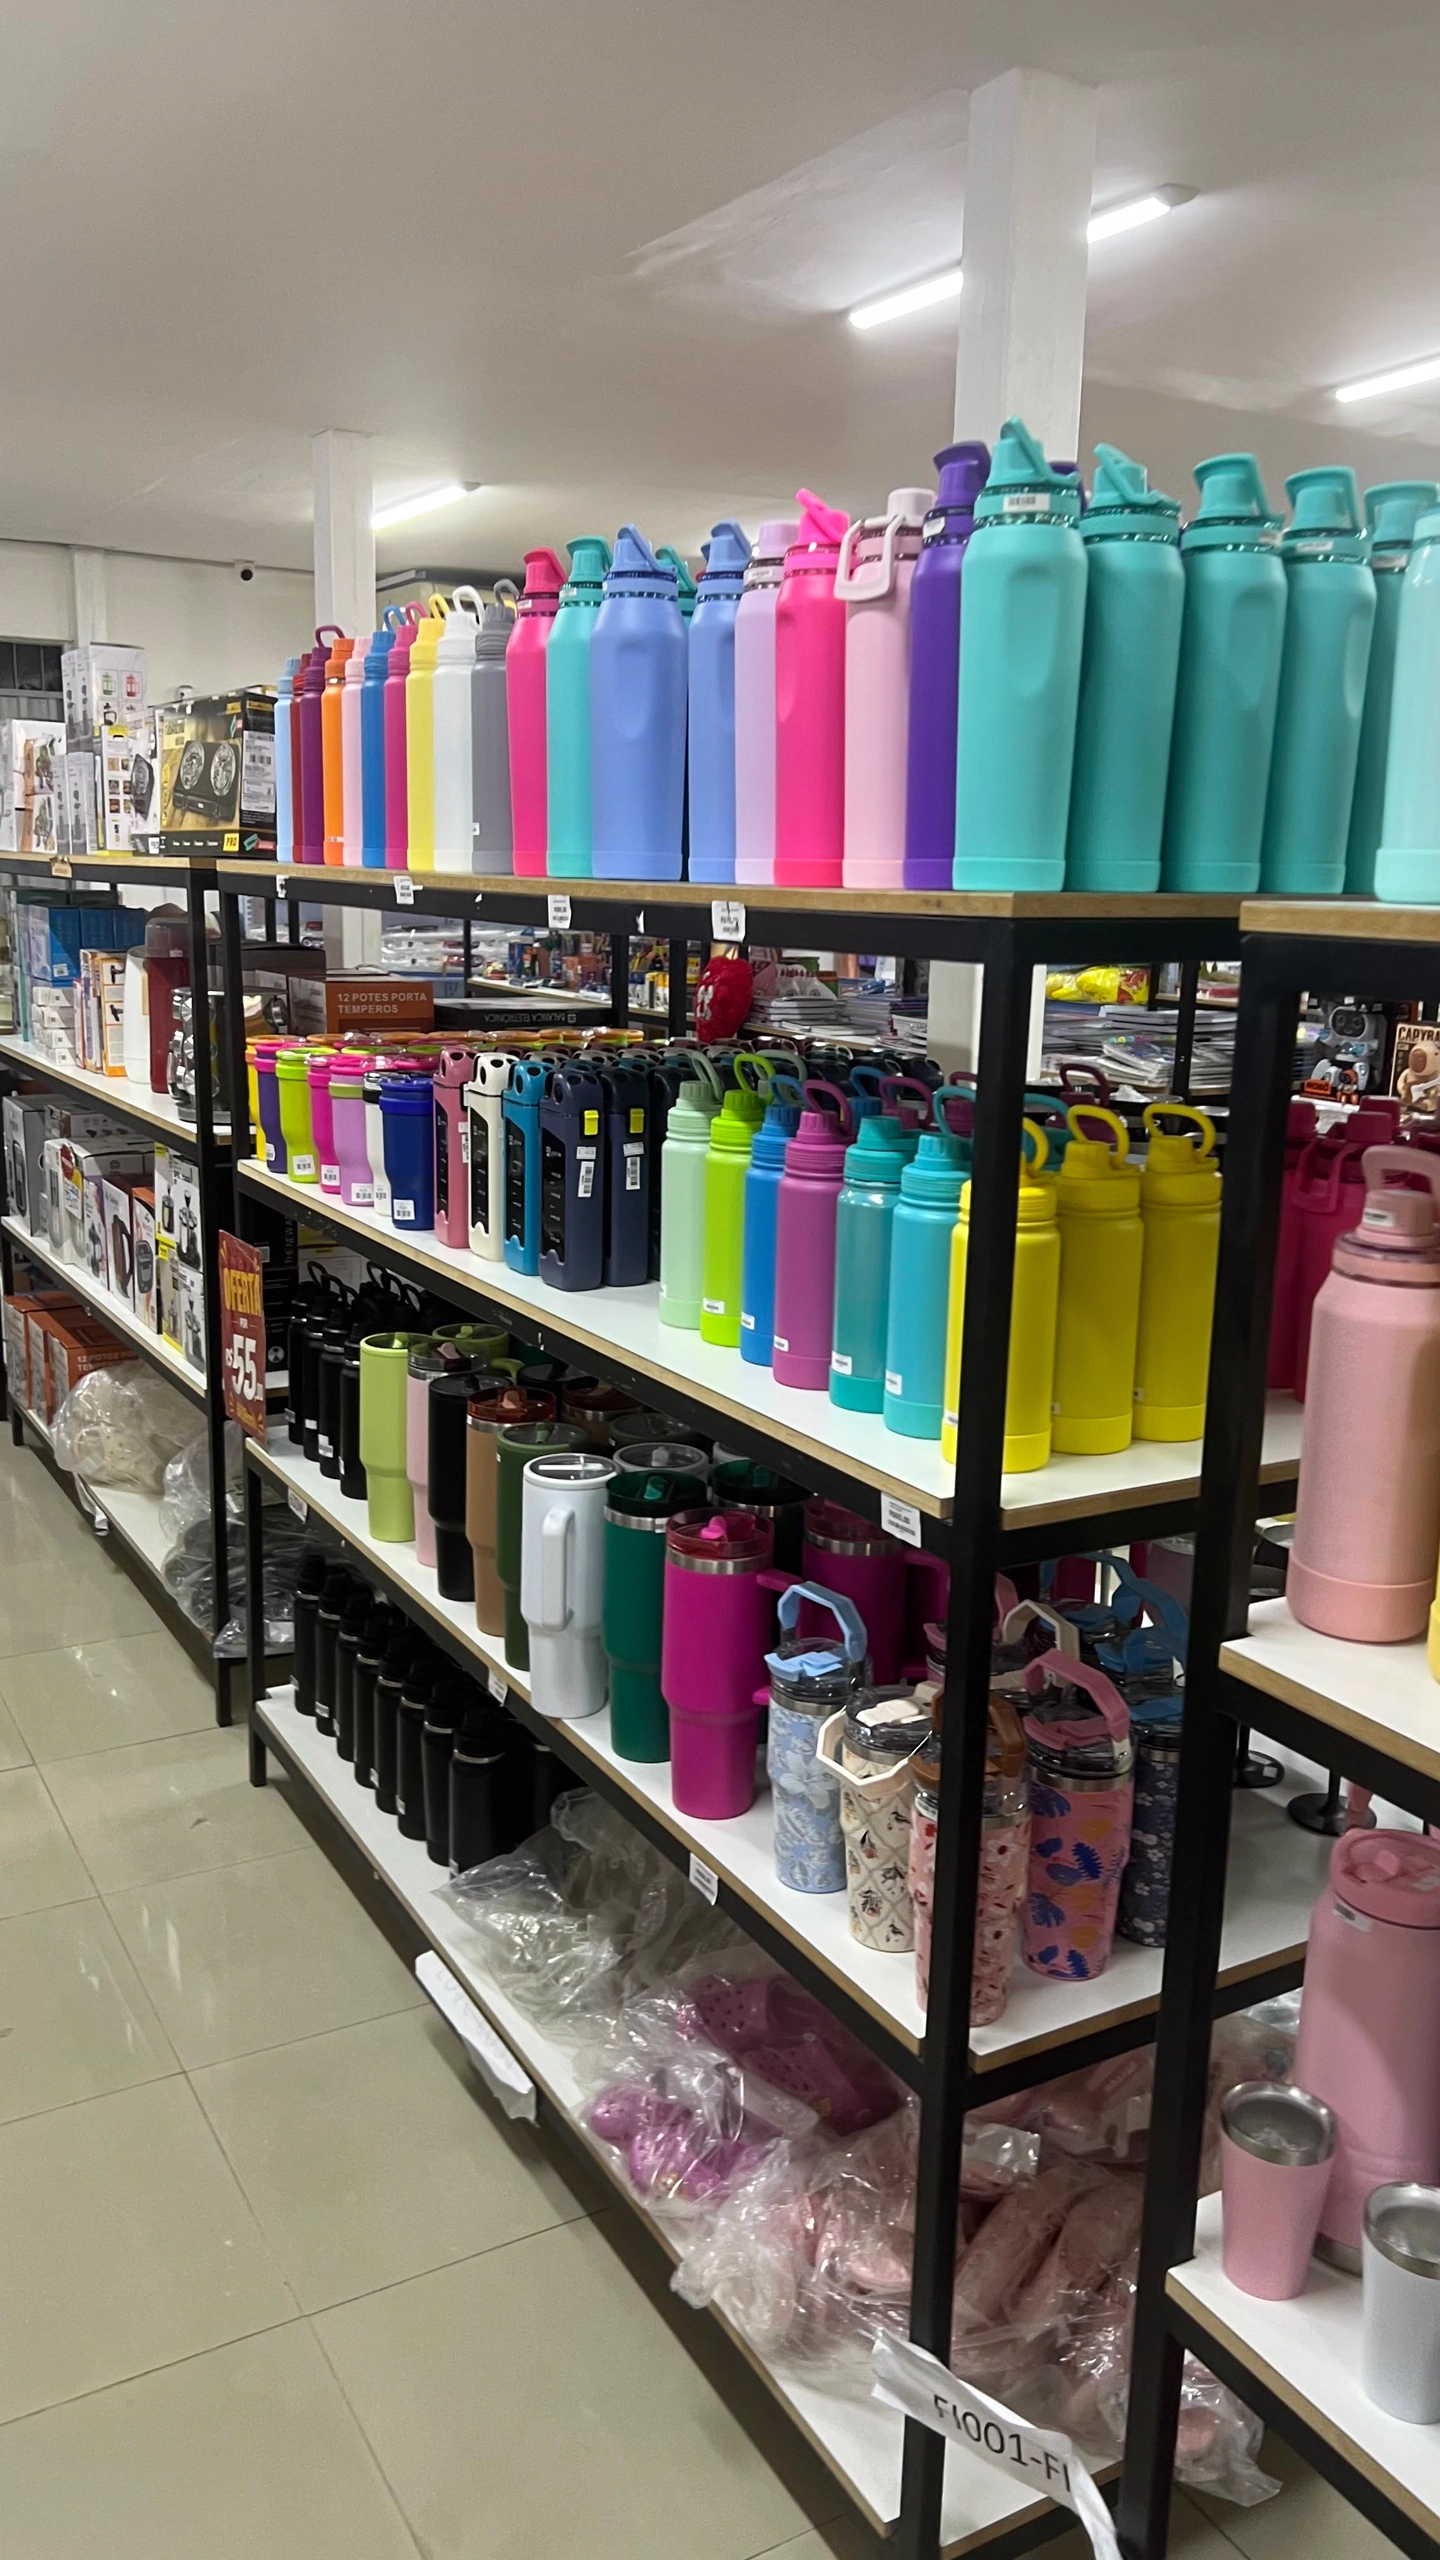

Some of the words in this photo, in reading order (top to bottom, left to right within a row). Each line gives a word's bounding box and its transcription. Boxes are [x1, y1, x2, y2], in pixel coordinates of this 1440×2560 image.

[226, 837, 237, 847] PRO
[338, 993, 351, 1002] 12
[352, 993, 389, 1002] POTES
[391, 992, 427, 1001] PORTA
[337, 1004, 399, 1014] TEMPEROS
[223, 1267, 262, 1317] OFERTA
